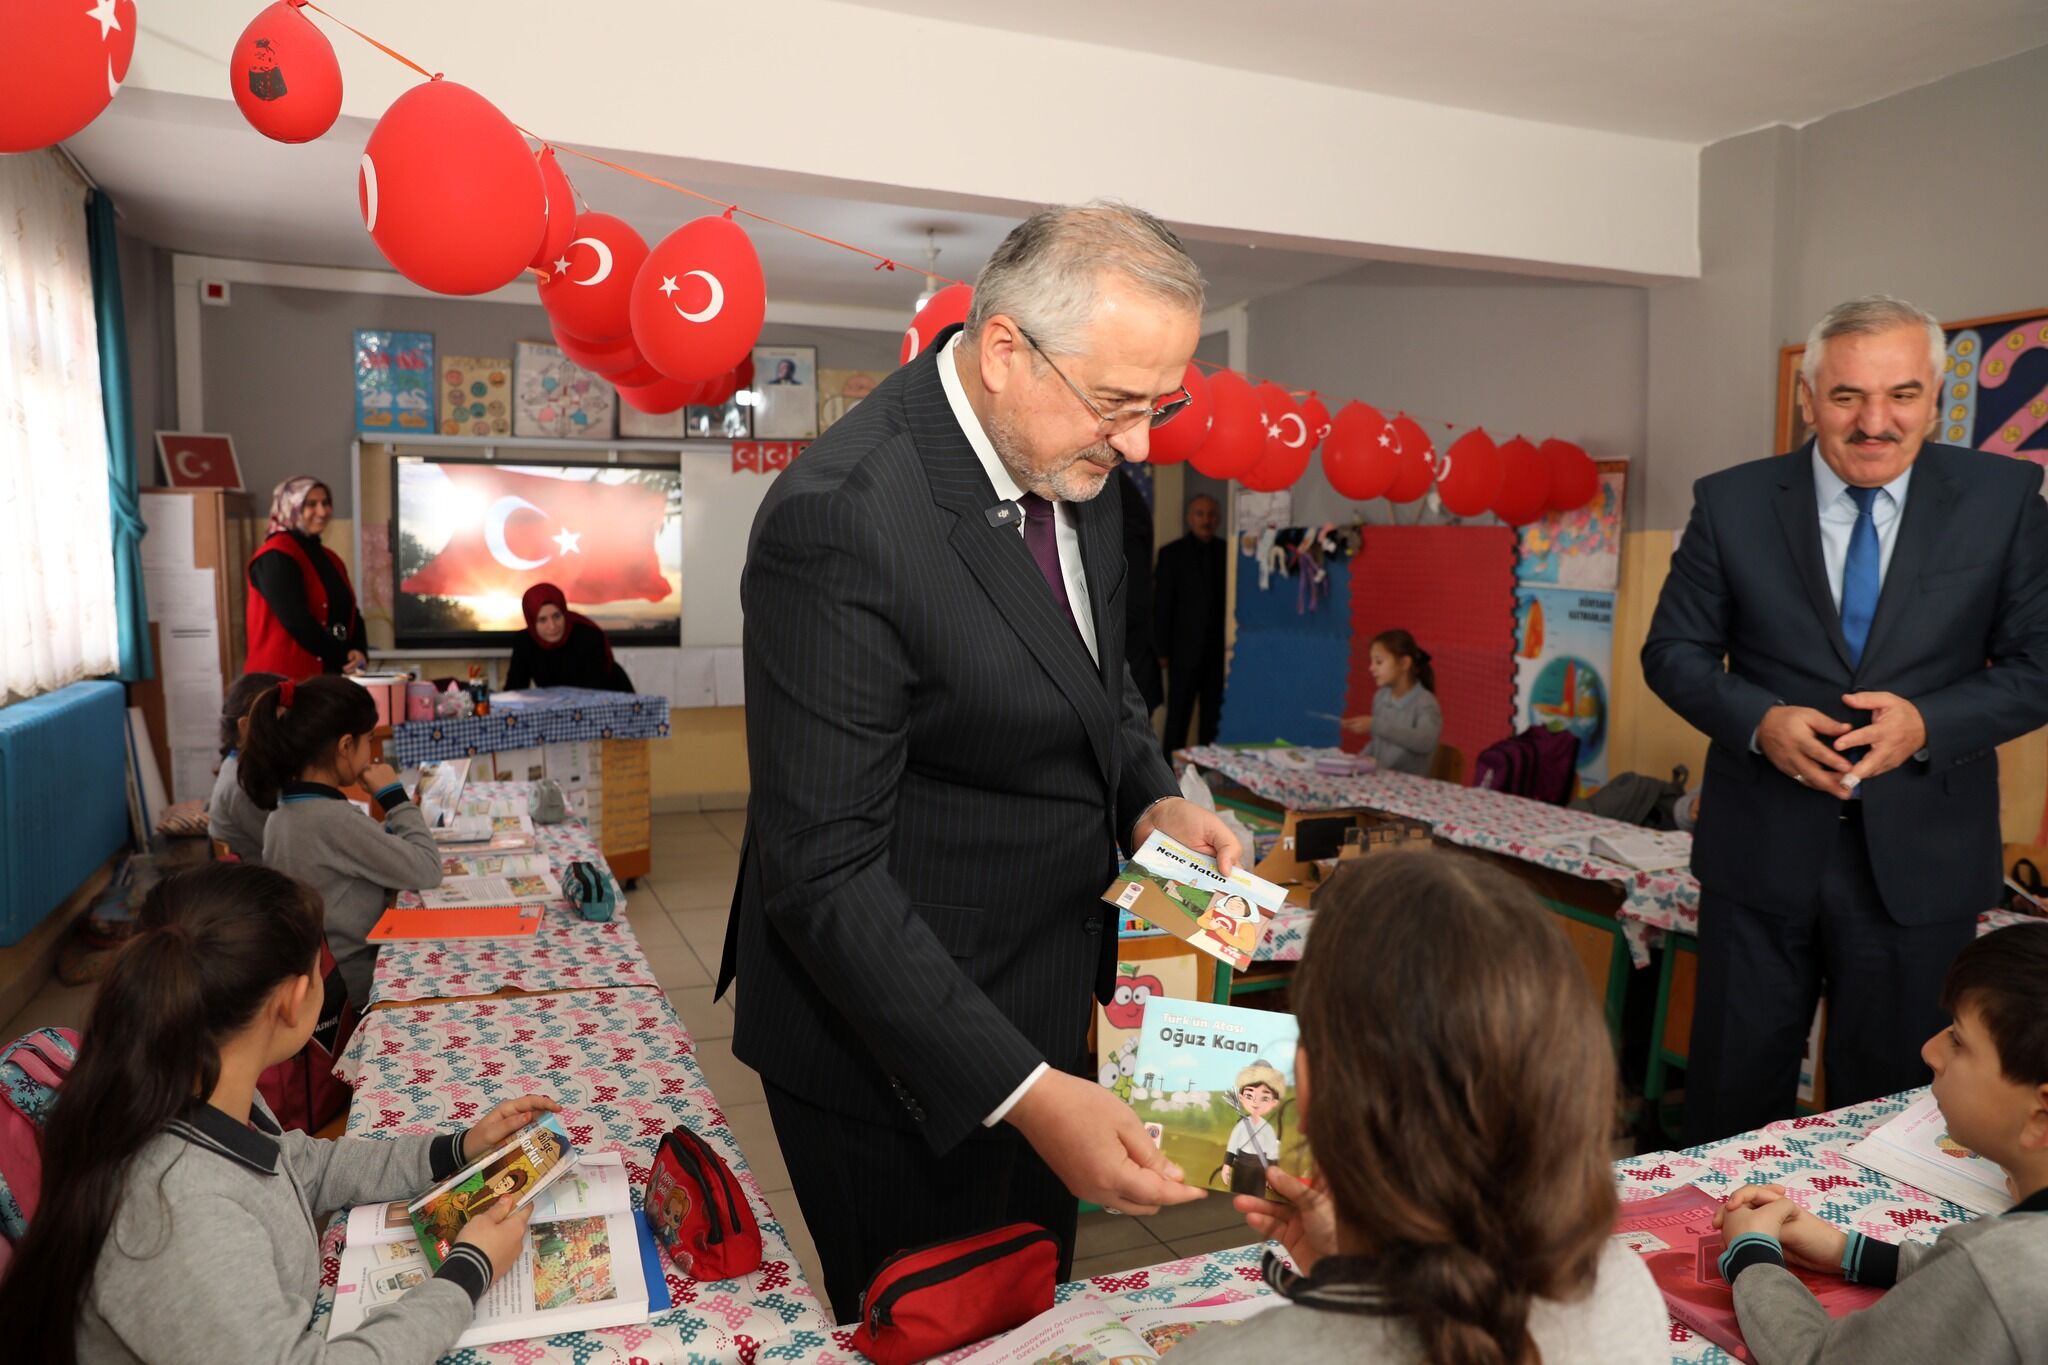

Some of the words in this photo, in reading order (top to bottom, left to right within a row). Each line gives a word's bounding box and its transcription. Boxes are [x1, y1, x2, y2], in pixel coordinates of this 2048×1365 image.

[1156, 846, 1186, 864] Nene
[1189, 862, 1227, 884] Hatun
[1160, 1027, 1206, 1048] Oğuz
[1212, 1034, 1259, 1054] Kaan
[537, 1131, 553, 1154] Bilge
[1012, 1326, 1053, 1354] MADDENİN
